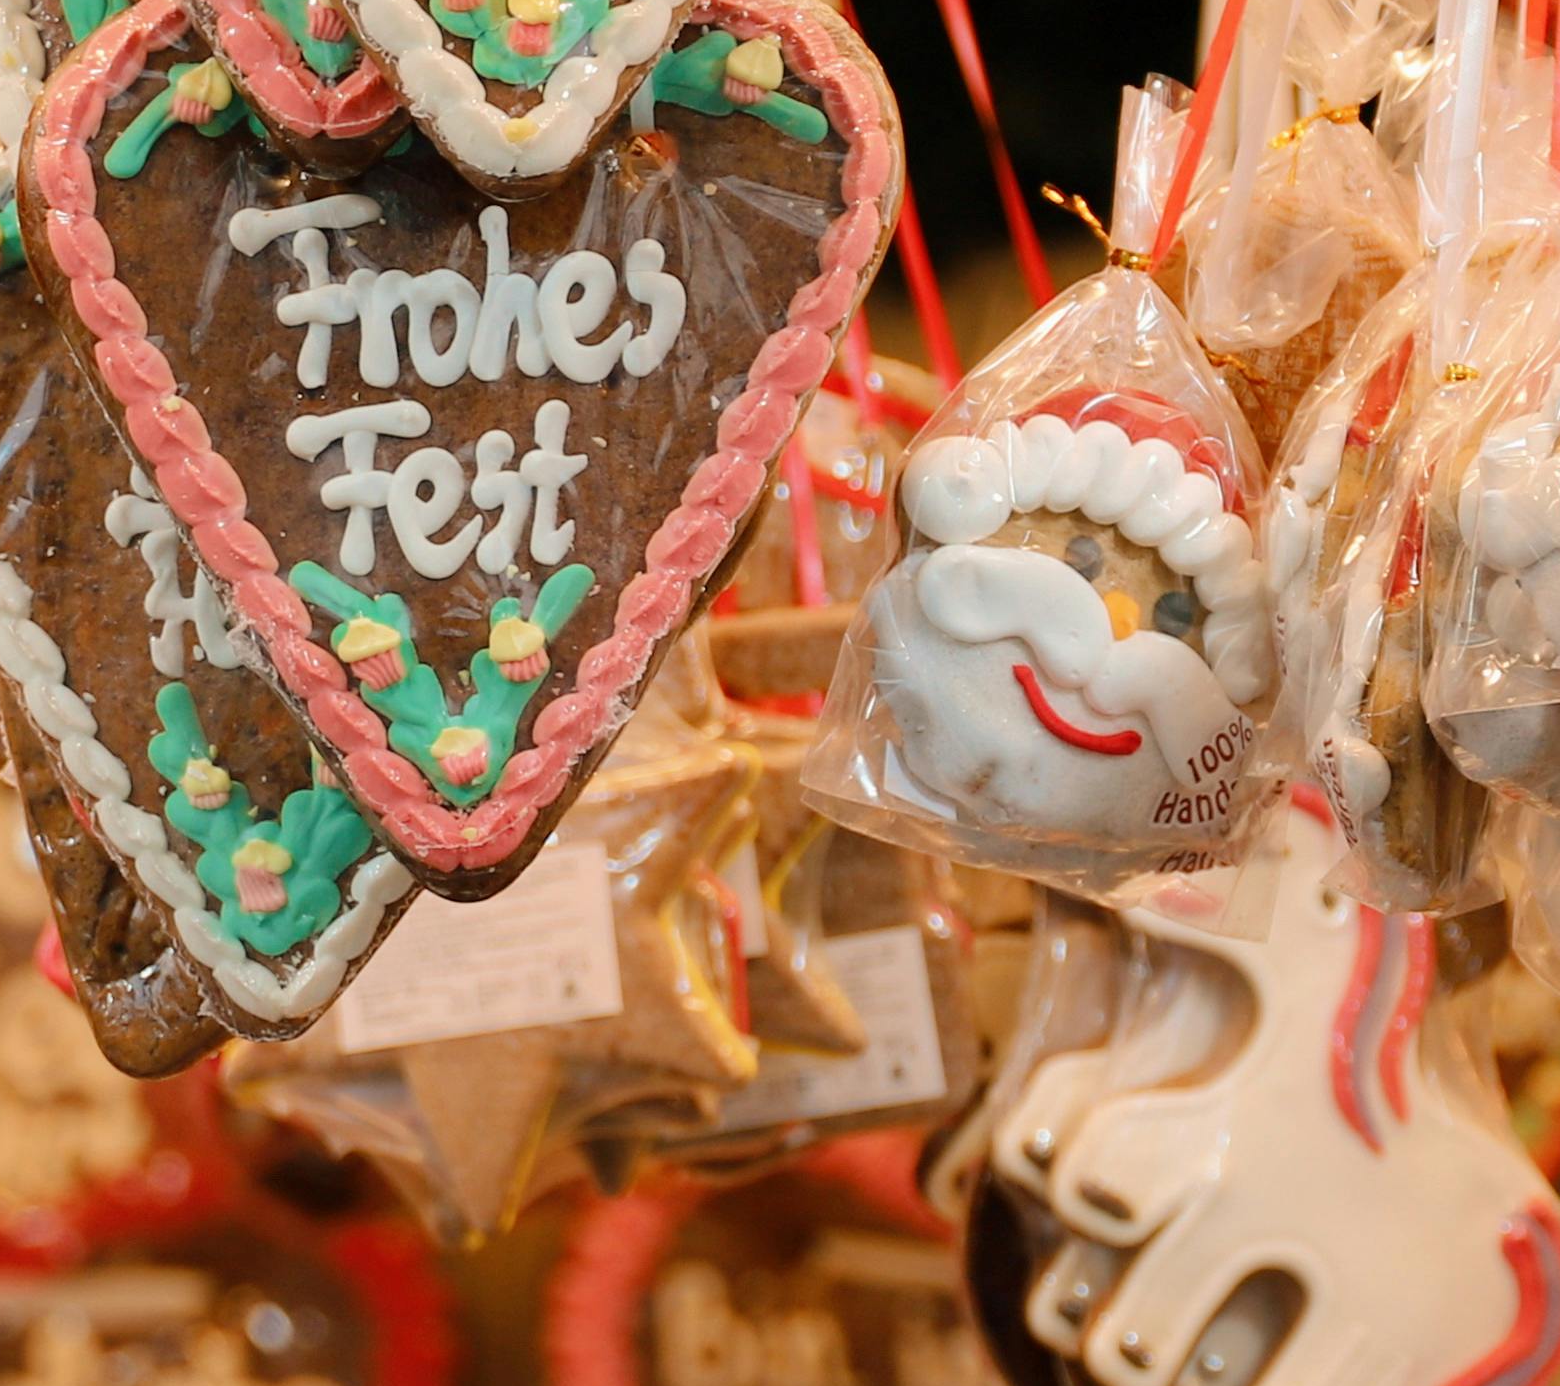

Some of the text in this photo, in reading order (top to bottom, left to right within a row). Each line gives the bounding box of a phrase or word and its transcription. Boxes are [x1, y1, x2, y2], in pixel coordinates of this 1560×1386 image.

[228, 194, 687, 388] Frohes
[286, 397, 588, 580] Fest
[1187, 715, 1254, 784] 100%
